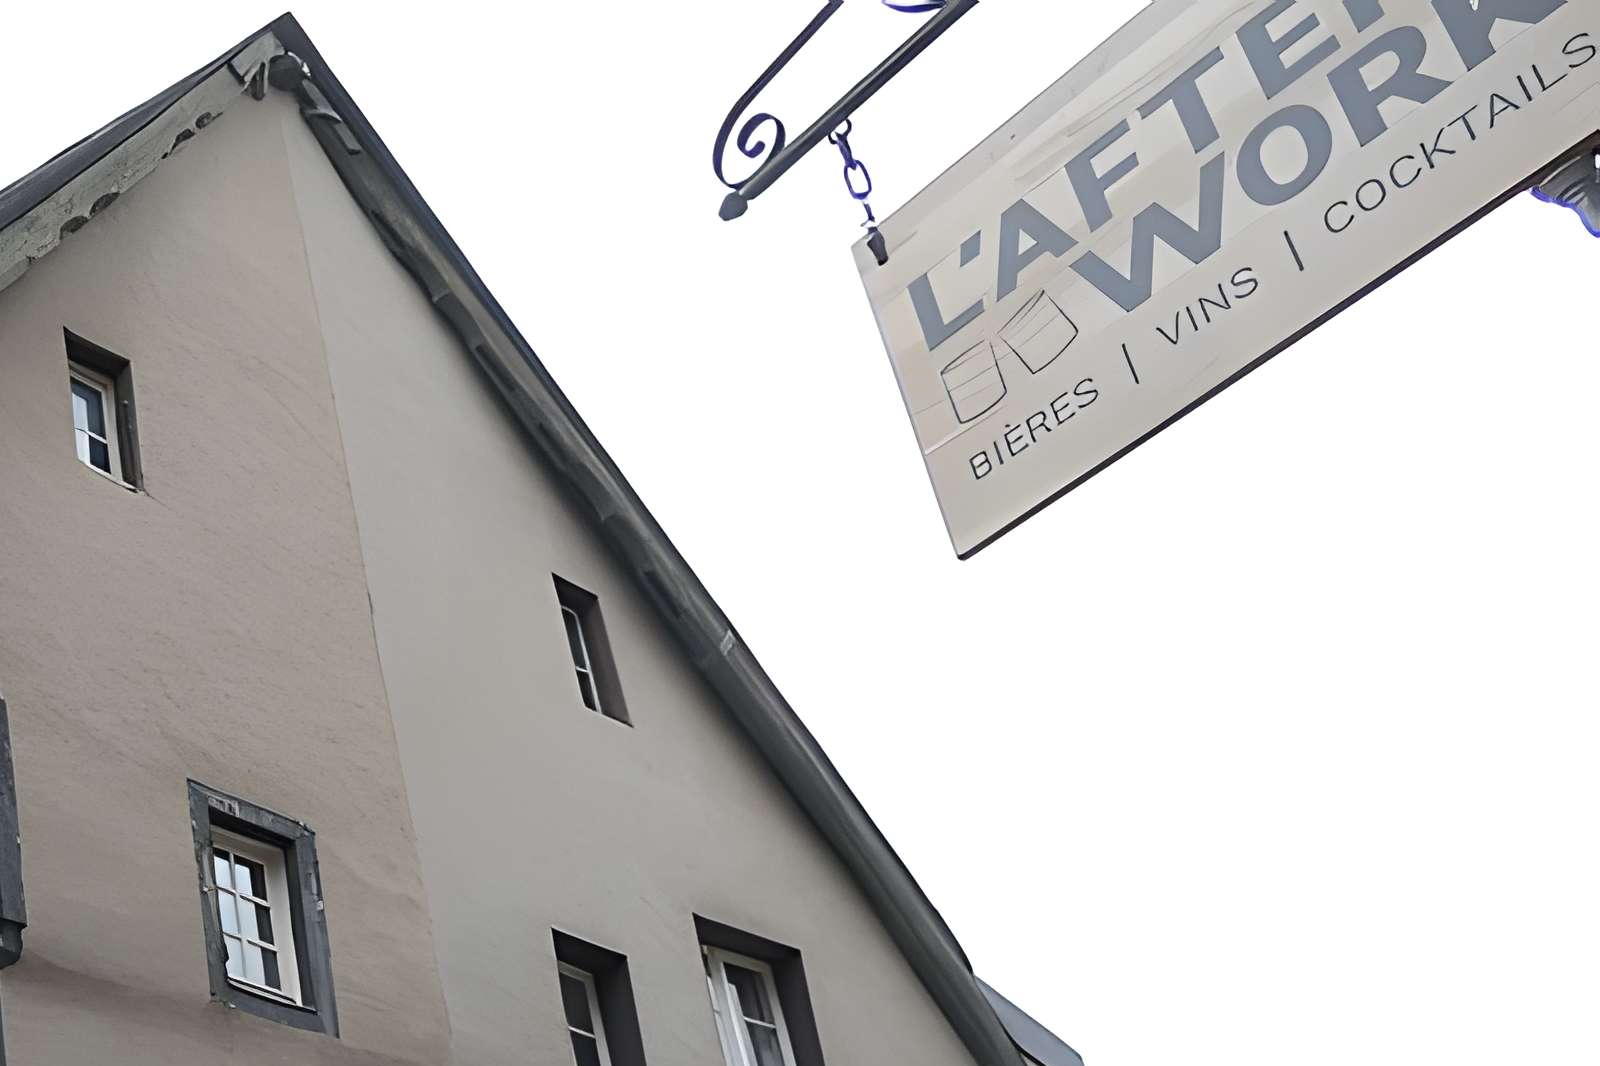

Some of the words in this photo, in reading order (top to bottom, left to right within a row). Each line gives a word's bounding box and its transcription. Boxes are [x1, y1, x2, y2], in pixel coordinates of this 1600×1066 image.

[907, 0, 1384, 351] L'AFTE
[969, 378, 1099, 479] BIÈRES
[1156, 267, 1258, 344] VINS
[1324, 33, 1596, 233] COCKTAILS
[1069, 0, 1568, 312] WORK
